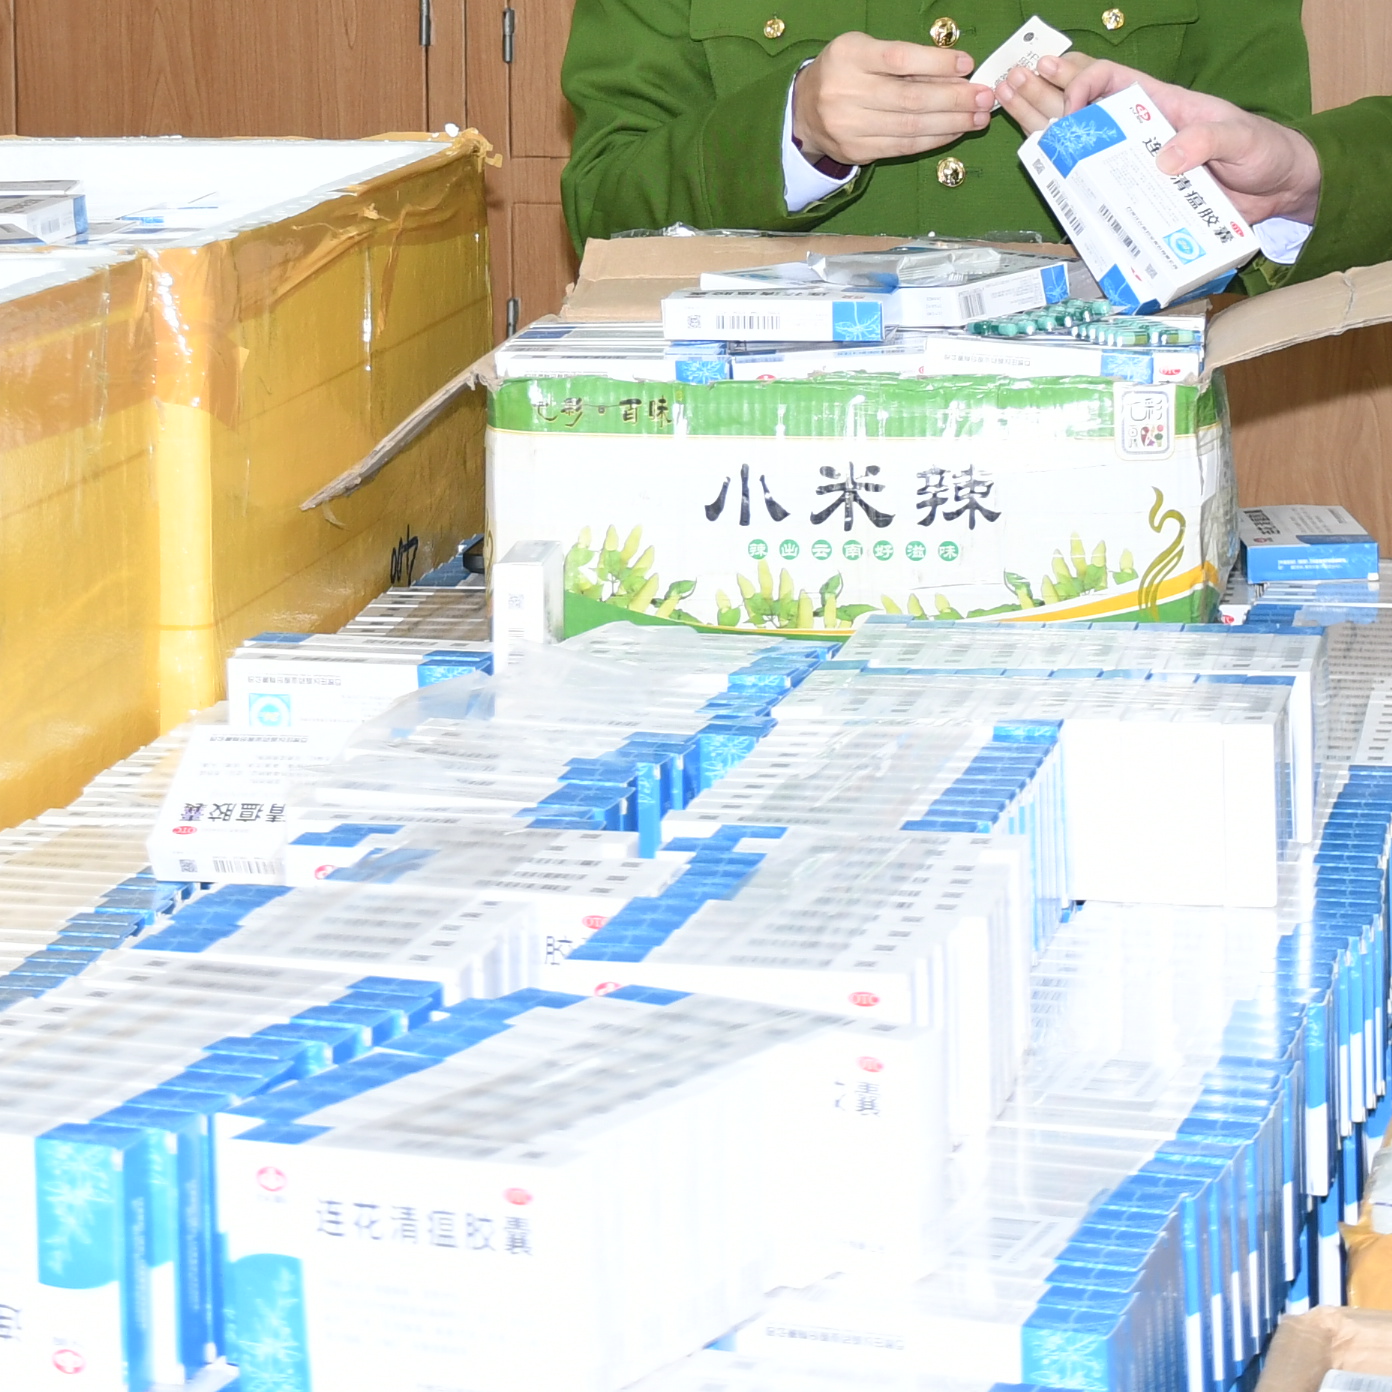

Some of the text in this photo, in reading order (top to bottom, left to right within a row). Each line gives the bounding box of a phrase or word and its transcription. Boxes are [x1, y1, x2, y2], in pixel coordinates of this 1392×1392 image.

[1141, 135, 1236, 245] 连清瘟胶囊
[705, 461, 1001, 531] 小米辣
[747, 538, 959, 562] 辣出云南好滋味
[316, 1195, 533, 1256] 连花清瘟胶囊
